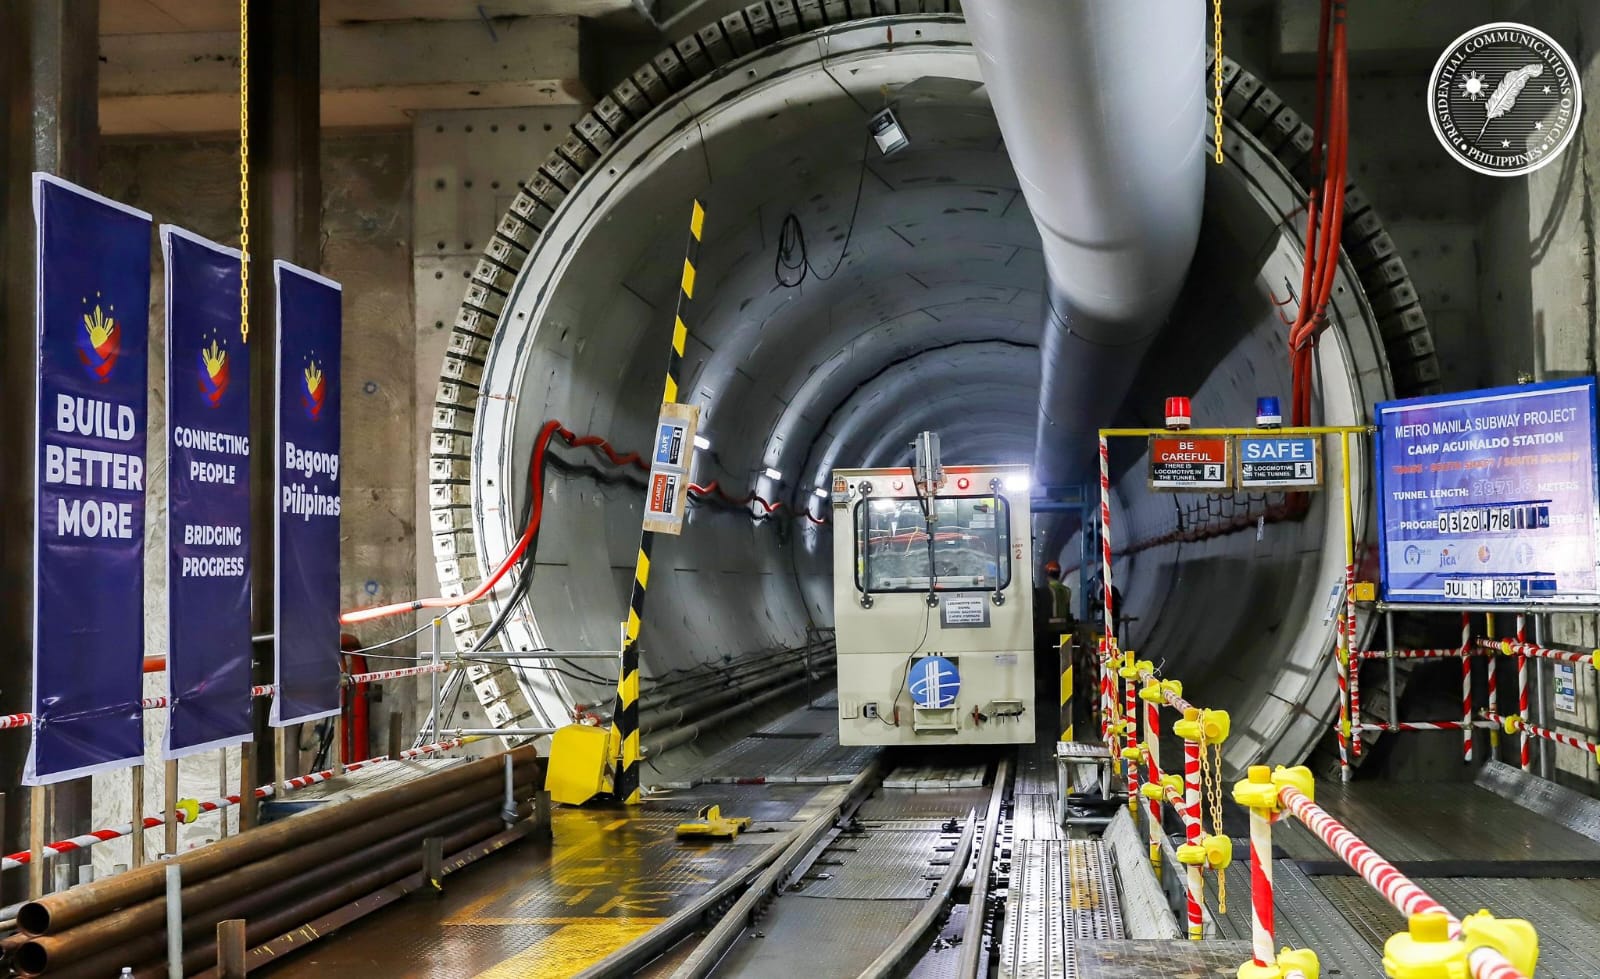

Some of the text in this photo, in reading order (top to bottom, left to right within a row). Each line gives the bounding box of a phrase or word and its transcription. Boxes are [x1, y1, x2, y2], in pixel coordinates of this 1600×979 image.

[57, 394, 136, 441] BUILD
[1395, 408, 1576, 439] METRO MANILA SUBWAY PROJECT
[174, 426, 249, 456] CONNECTING
[661, 434, 670, 453] SAFE
[1179, 442, 1194, 450] BE
[1248, 443, 1304, 458] SAFE
[1408, 432, 1564, 455] CAMP AGUINALDO STATION
[46, 445, 143, 491] BETTER
[286, 441, 339, 482] Bagong
[1162, 453, 1211, 461] CAREFUL
[190, 461, 236, 485] PEOPLE
[282, 483, 341, 521] Pilipinas
[1393, 490, 1428, 500] TUNNEL
[1431, 488, 1469, 498] LENGTH:
[57, 499, 132, 539] MORE
[184, 525, 242, 546] BRIDGING
[1015, 549, 1023, 560] 2
[182, 557, 244, 577] PROGRESS
[1446, 583, 1467, 596] JUL
[1496, 582, 1519, 596] 2025
